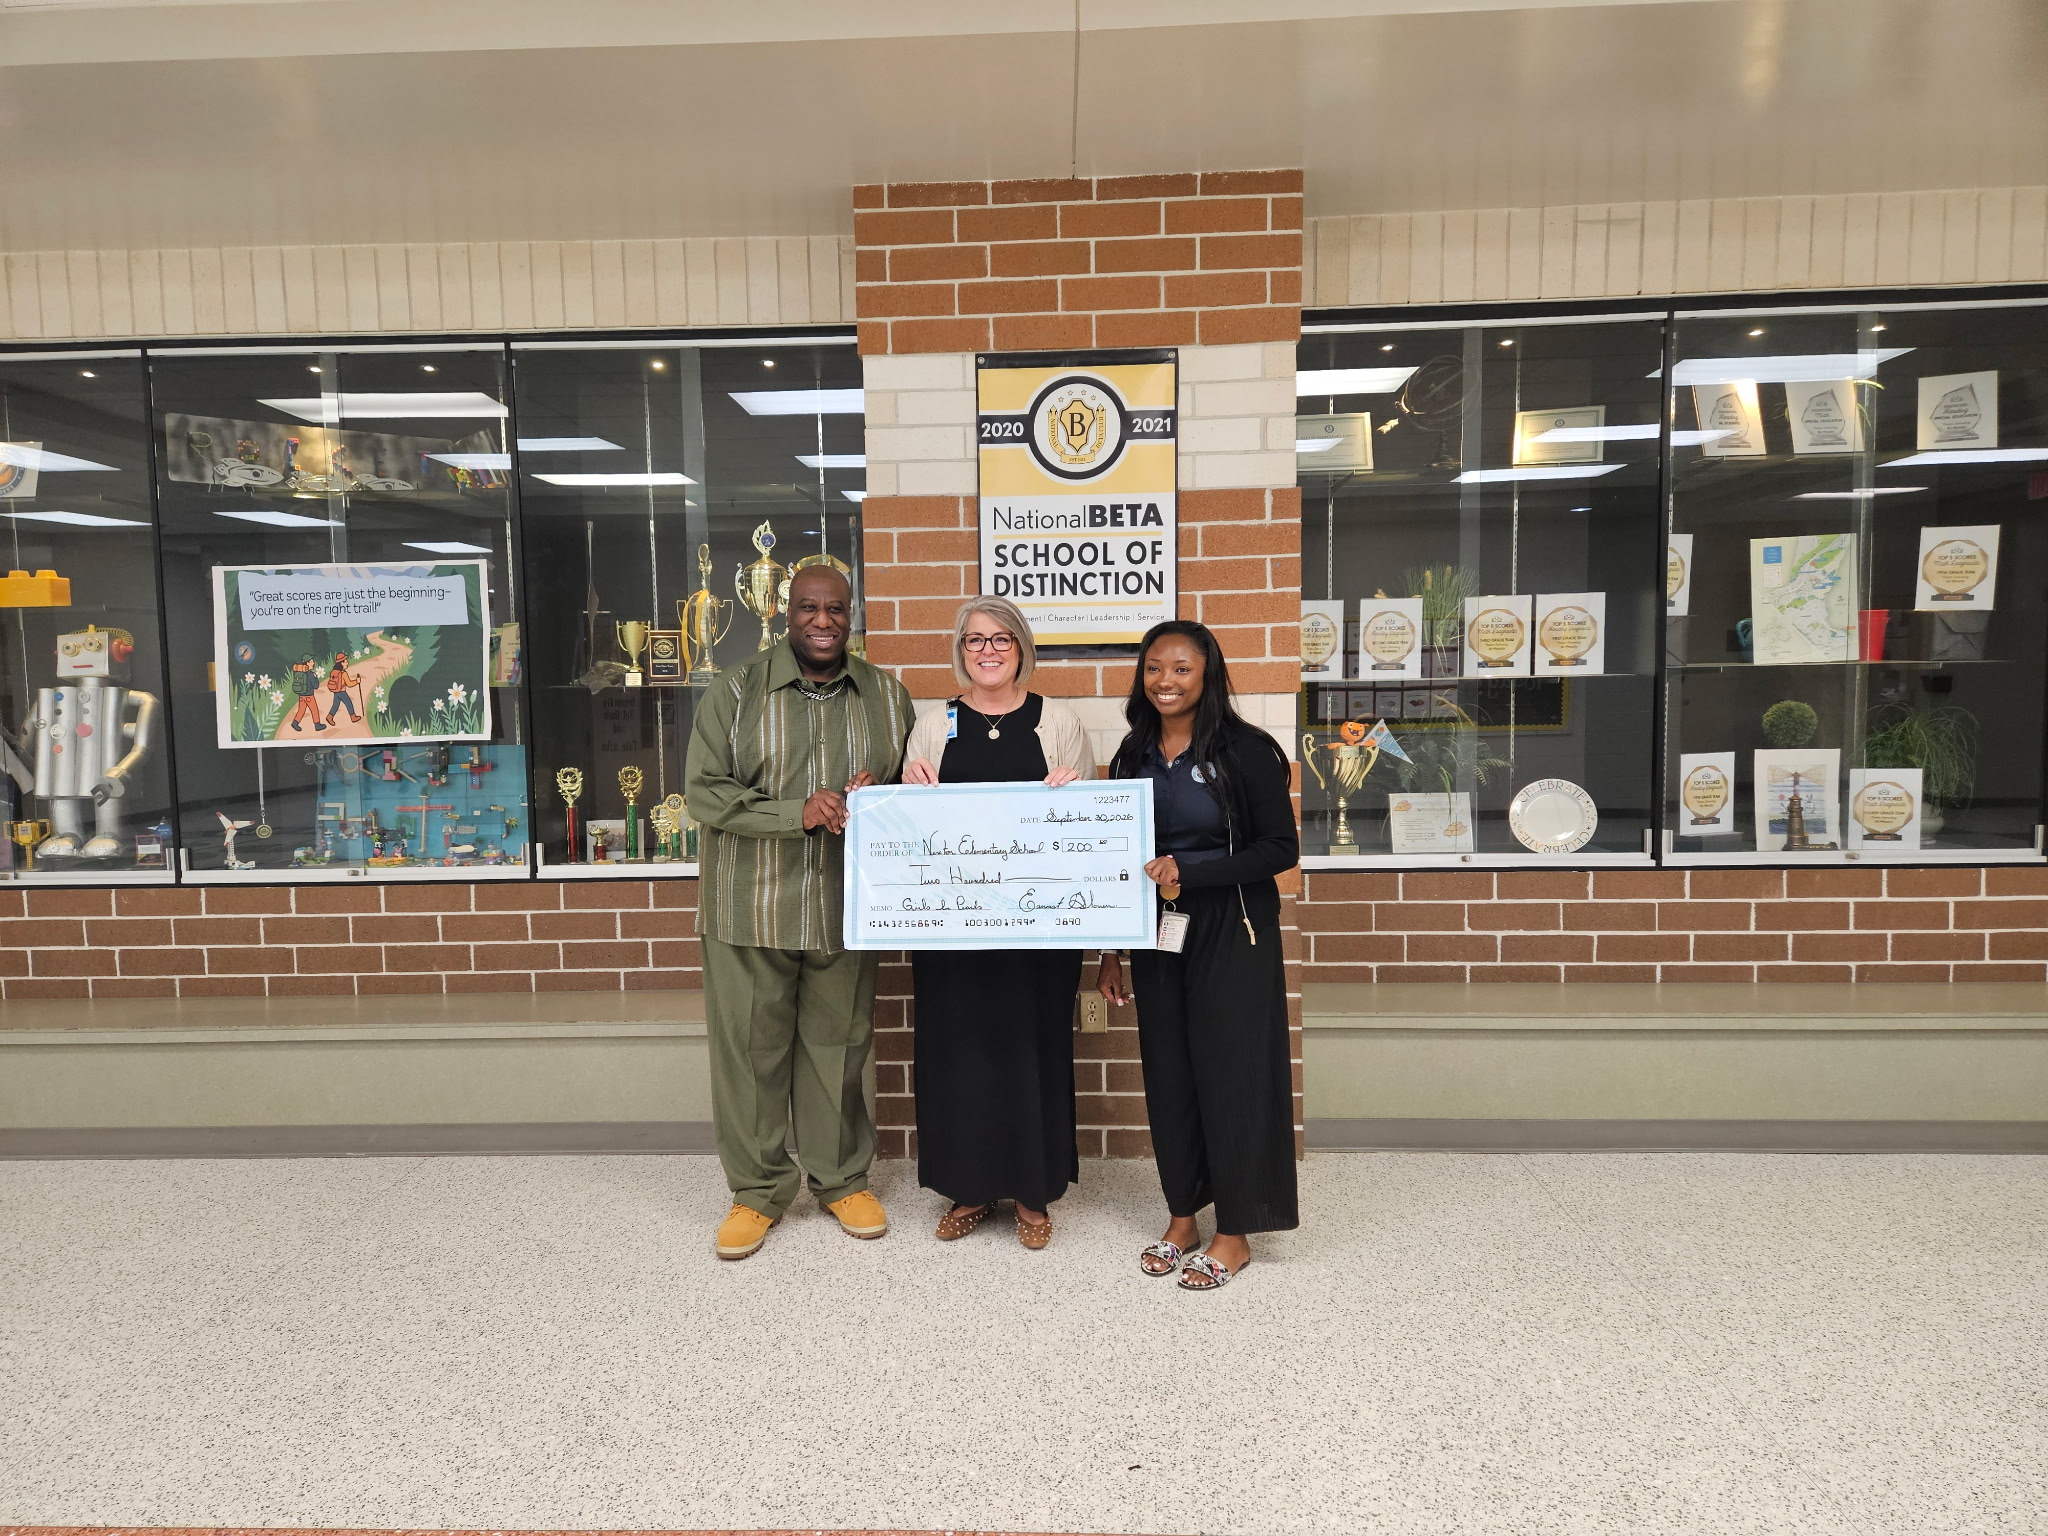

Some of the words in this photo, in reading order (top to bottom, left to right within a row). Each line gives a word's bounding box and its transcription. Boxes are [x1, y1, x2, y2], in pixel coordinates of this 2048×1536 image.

[981, 421, 1025, 438] 2020
[1069, 412, 1086, 437] B
[1132, 417, 1172, 433] 2021
[994, 541, 1115, 568] SCHOOL
[1126, 540, 1163, 566] OF
[993, 570, 1164, 597] DISTINCTION
[286, 590, 322, 601] scores
[324, 590, 342, 600] are
[343, 588, 365, 603] just
[367, 587, 386, 599] the
[286, 605, 301, 616] on
[303, 603, 322, 615] the
[324, 602, 351, 618] right
[1048, 614, 1084, 622] Character
[1090, 613, 1131, 622] Leadership
[1137, 613, 1165, 621] Service
[1093, 795, 1130, 804] 1223477
[1519, 780, 1587, 803] CELEBRATE
[1020, 816, 1041, 824] DATE
[1043, 807, 1092, 827] September
[958, 834, 1008, 862] Elementary
[1009, 839, 1045, 855] School
[1052, 841, 1060, 851] $
[909, 864, 941, 886] Two
[902, 897, 931, 911] Girls
[956, 895, 983, 911] Pearls
